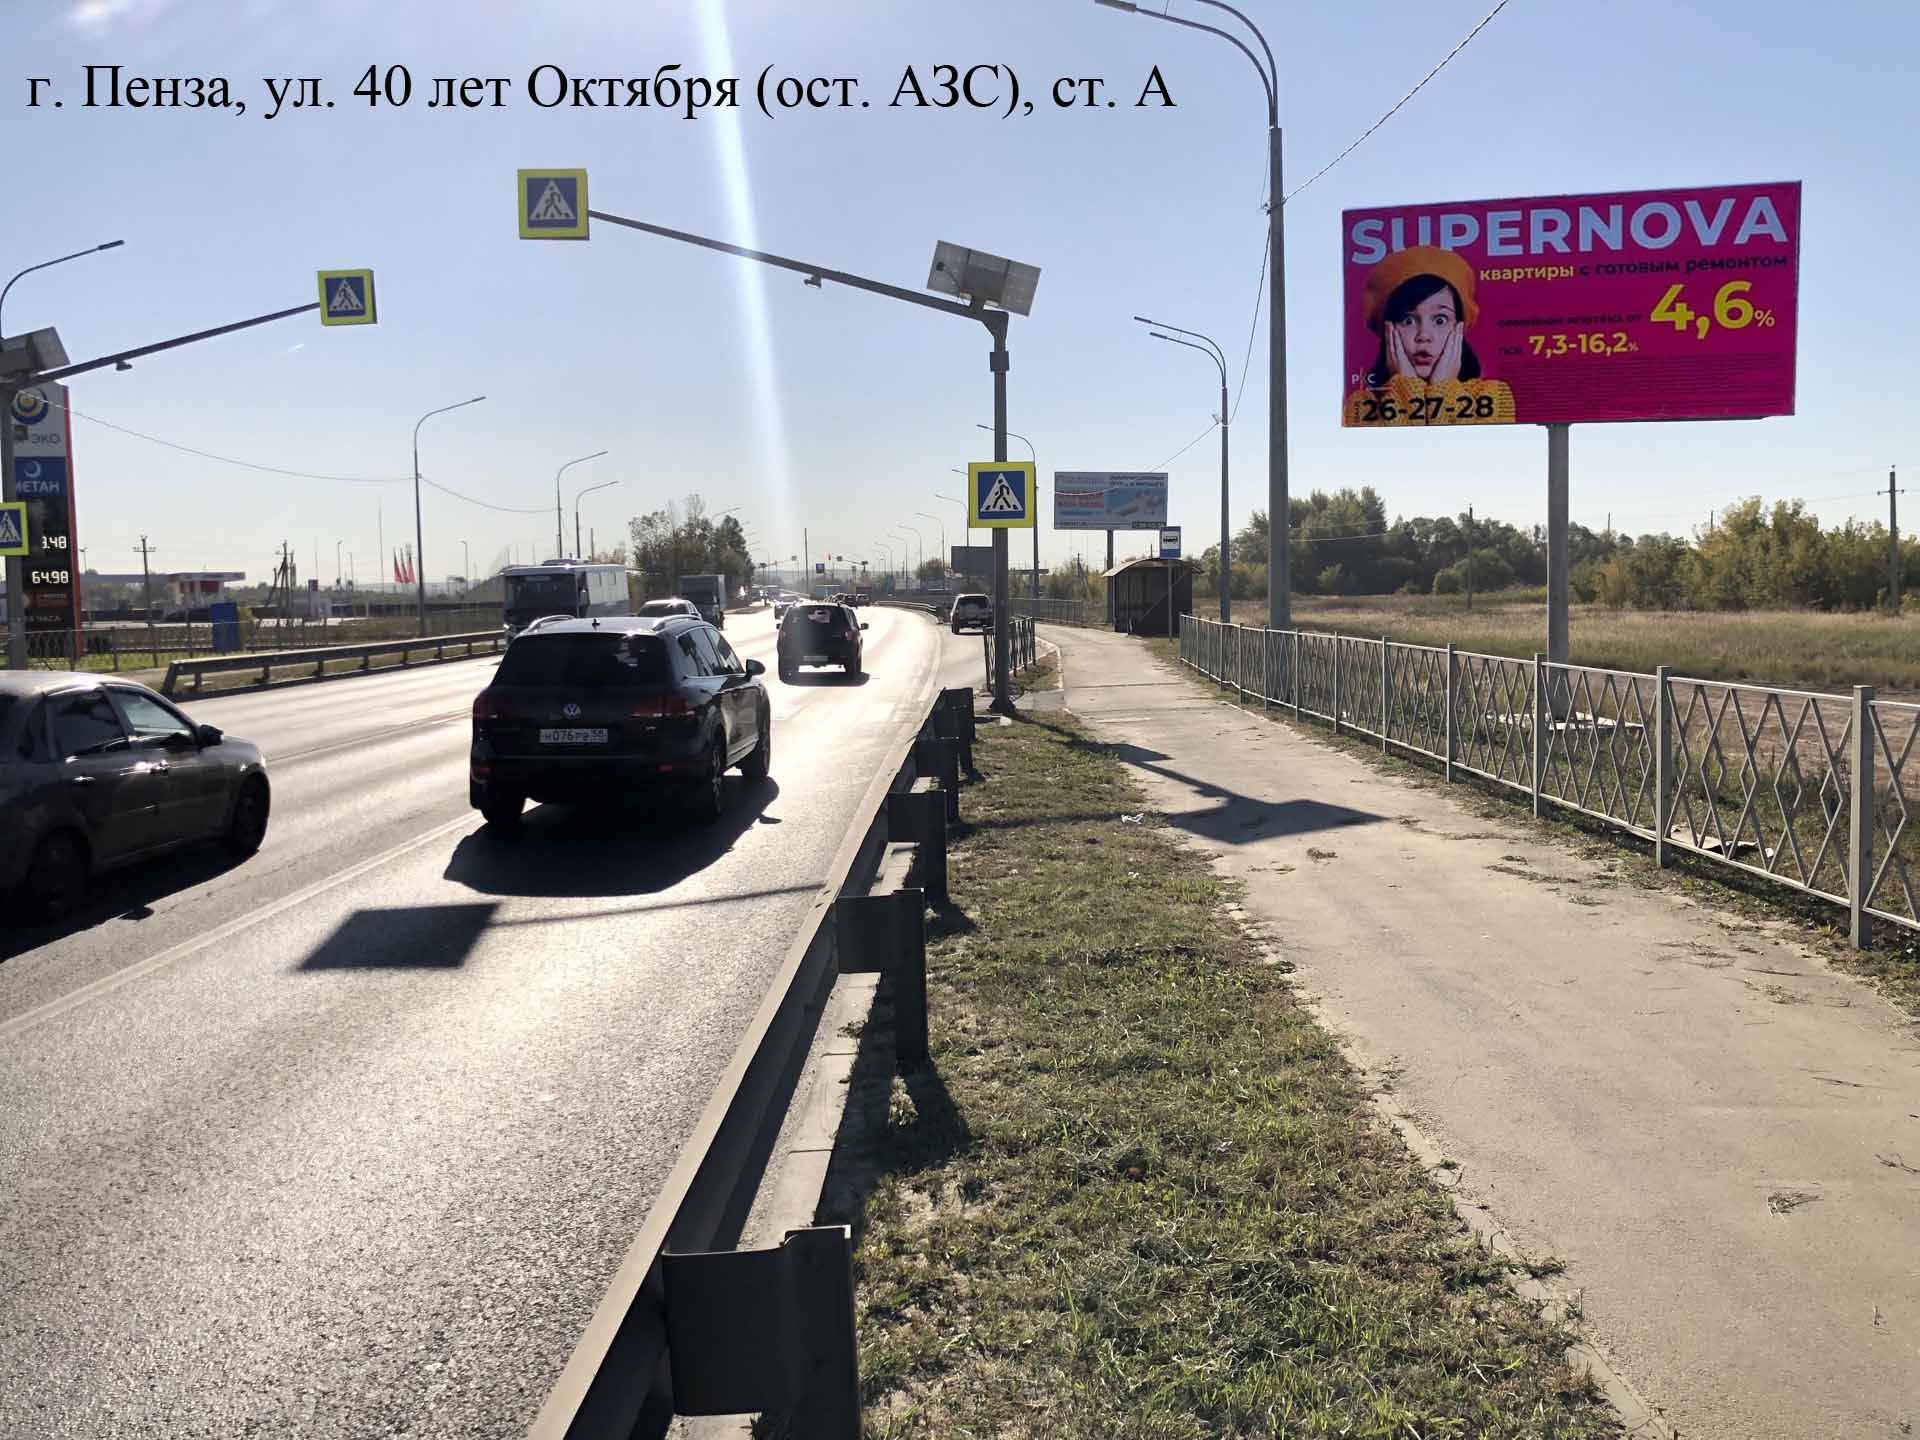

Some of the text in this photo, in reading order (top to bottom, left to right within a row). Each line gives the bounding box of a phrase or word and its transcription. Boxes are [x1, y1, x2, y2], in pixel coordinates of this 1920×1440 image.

[1351, 196, 1788, 265] SUPERNOVA
[1479, 254, 1788, 283] квартиры с готовым ремонтом
[1360, 394, 1495, 423] 26-27-28
